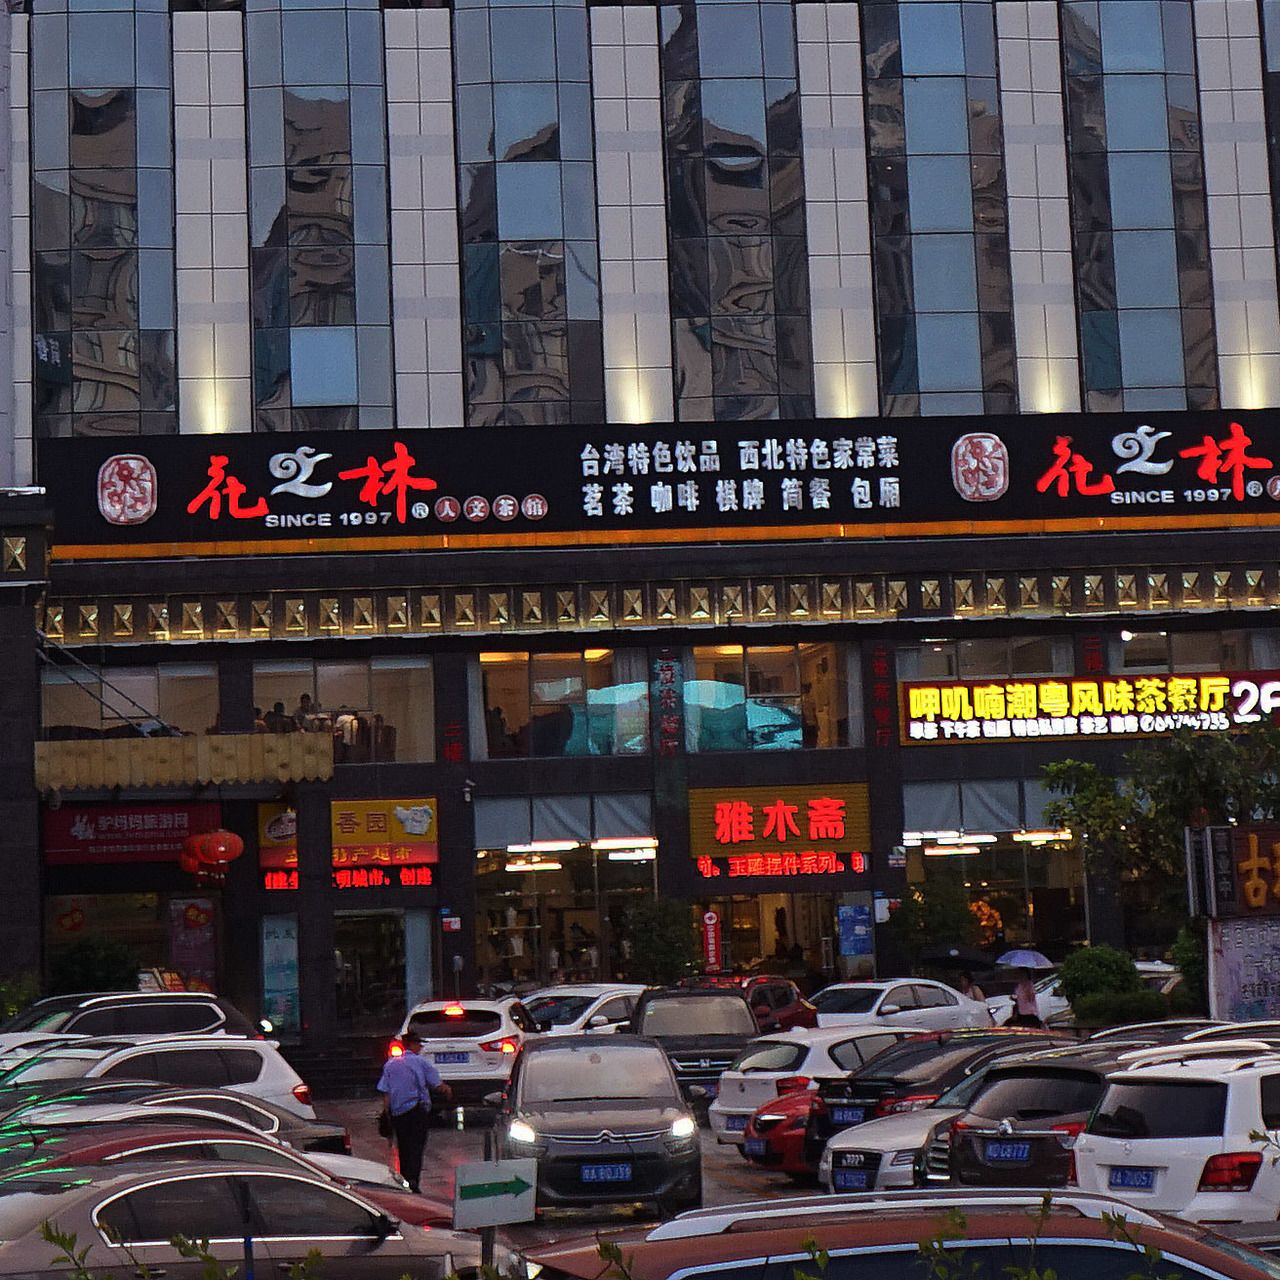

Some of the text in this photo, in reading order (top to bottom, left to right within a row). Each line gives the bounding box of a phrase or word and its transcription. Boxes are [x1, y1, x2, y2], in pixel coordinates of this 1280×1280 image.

[580, 435, 899, 477] 台湾特色饮品 西北特色家常菜
[581, 482, 635, 517] 茗茶
[650, 480, 700, 513] 咖啡
[716, 479, 765, 512] 棋牌
[1110, 487, 1231, 505] SINCE 1997
[264, 511, 393, 528] SINCE 1997
[336, 811, 389, 834] 香园
[714, 797, 847, 844] 雅木斋
